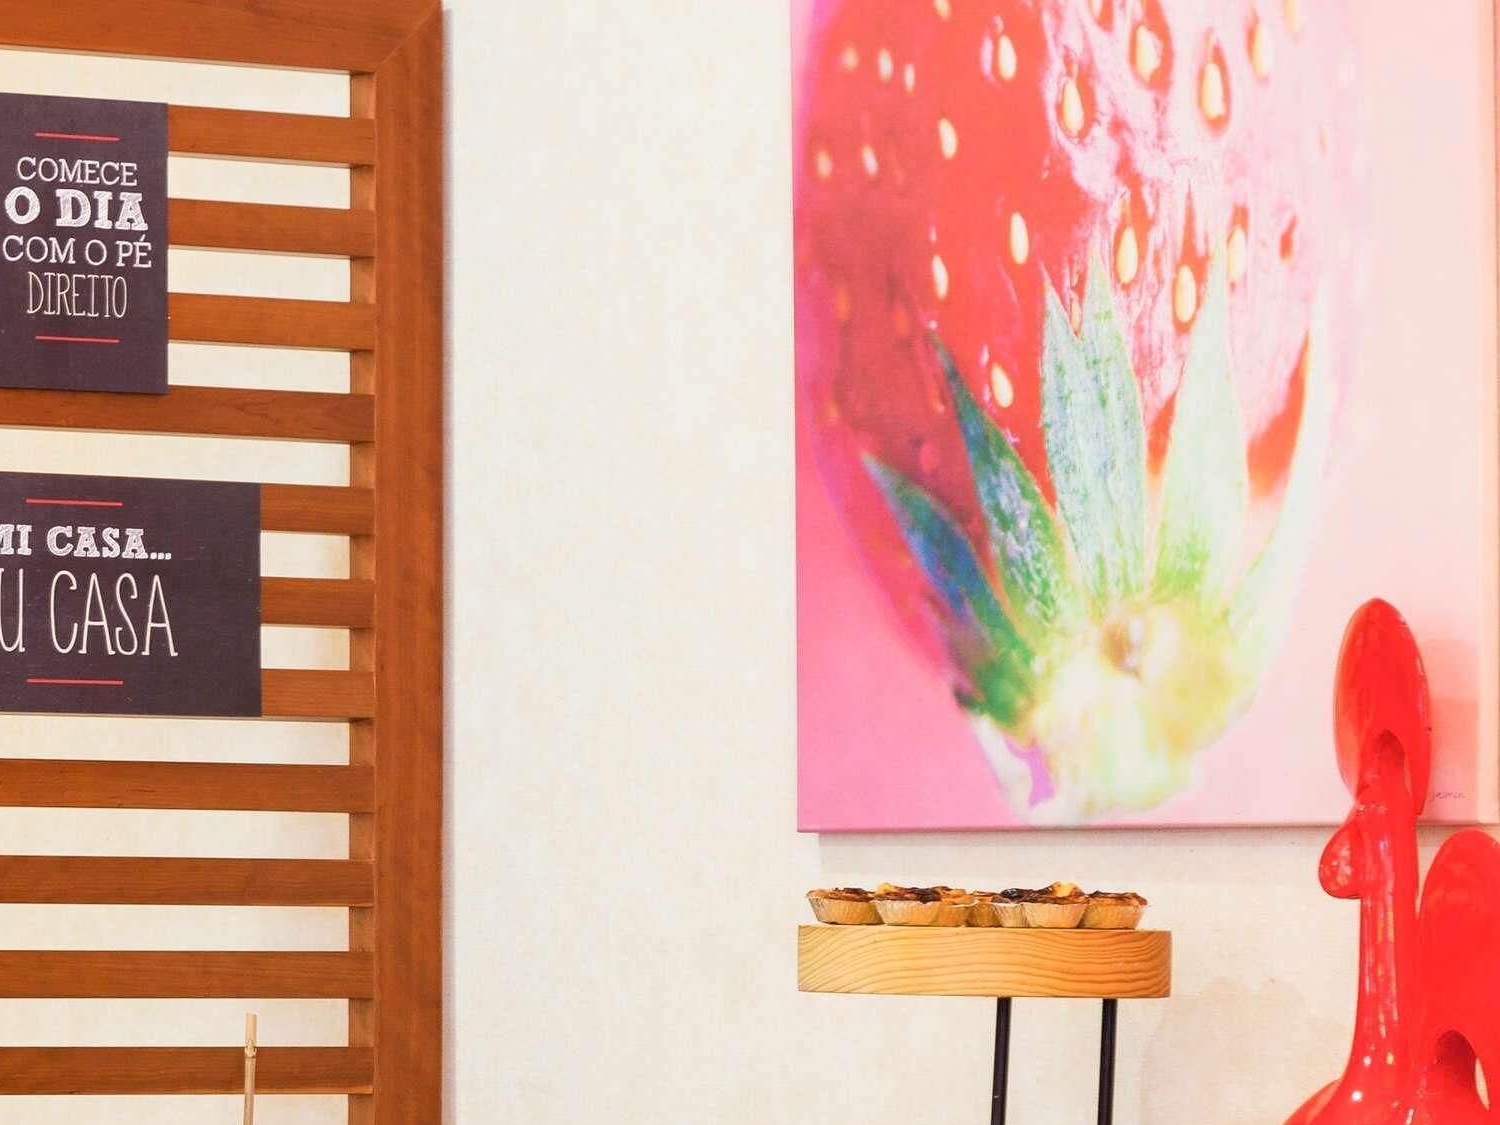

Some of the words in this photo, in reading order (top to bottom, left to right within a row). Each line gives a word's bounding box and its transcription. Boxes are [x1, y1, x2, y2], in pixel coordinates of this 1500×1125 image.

[17, 157, 137, 187] COMECE
[5, 187, 40, 224] O
[56, 189, 148, 230] DIA
[3, 235, 75, 264] COM
[85, 240, 107, 265] O
[116, 234, 151, 268] PÉ
[27, 271, 127, 318] DIREITO
[47, 526, 171, 560] CASA...
[51, 571, 178, 656] CASA
